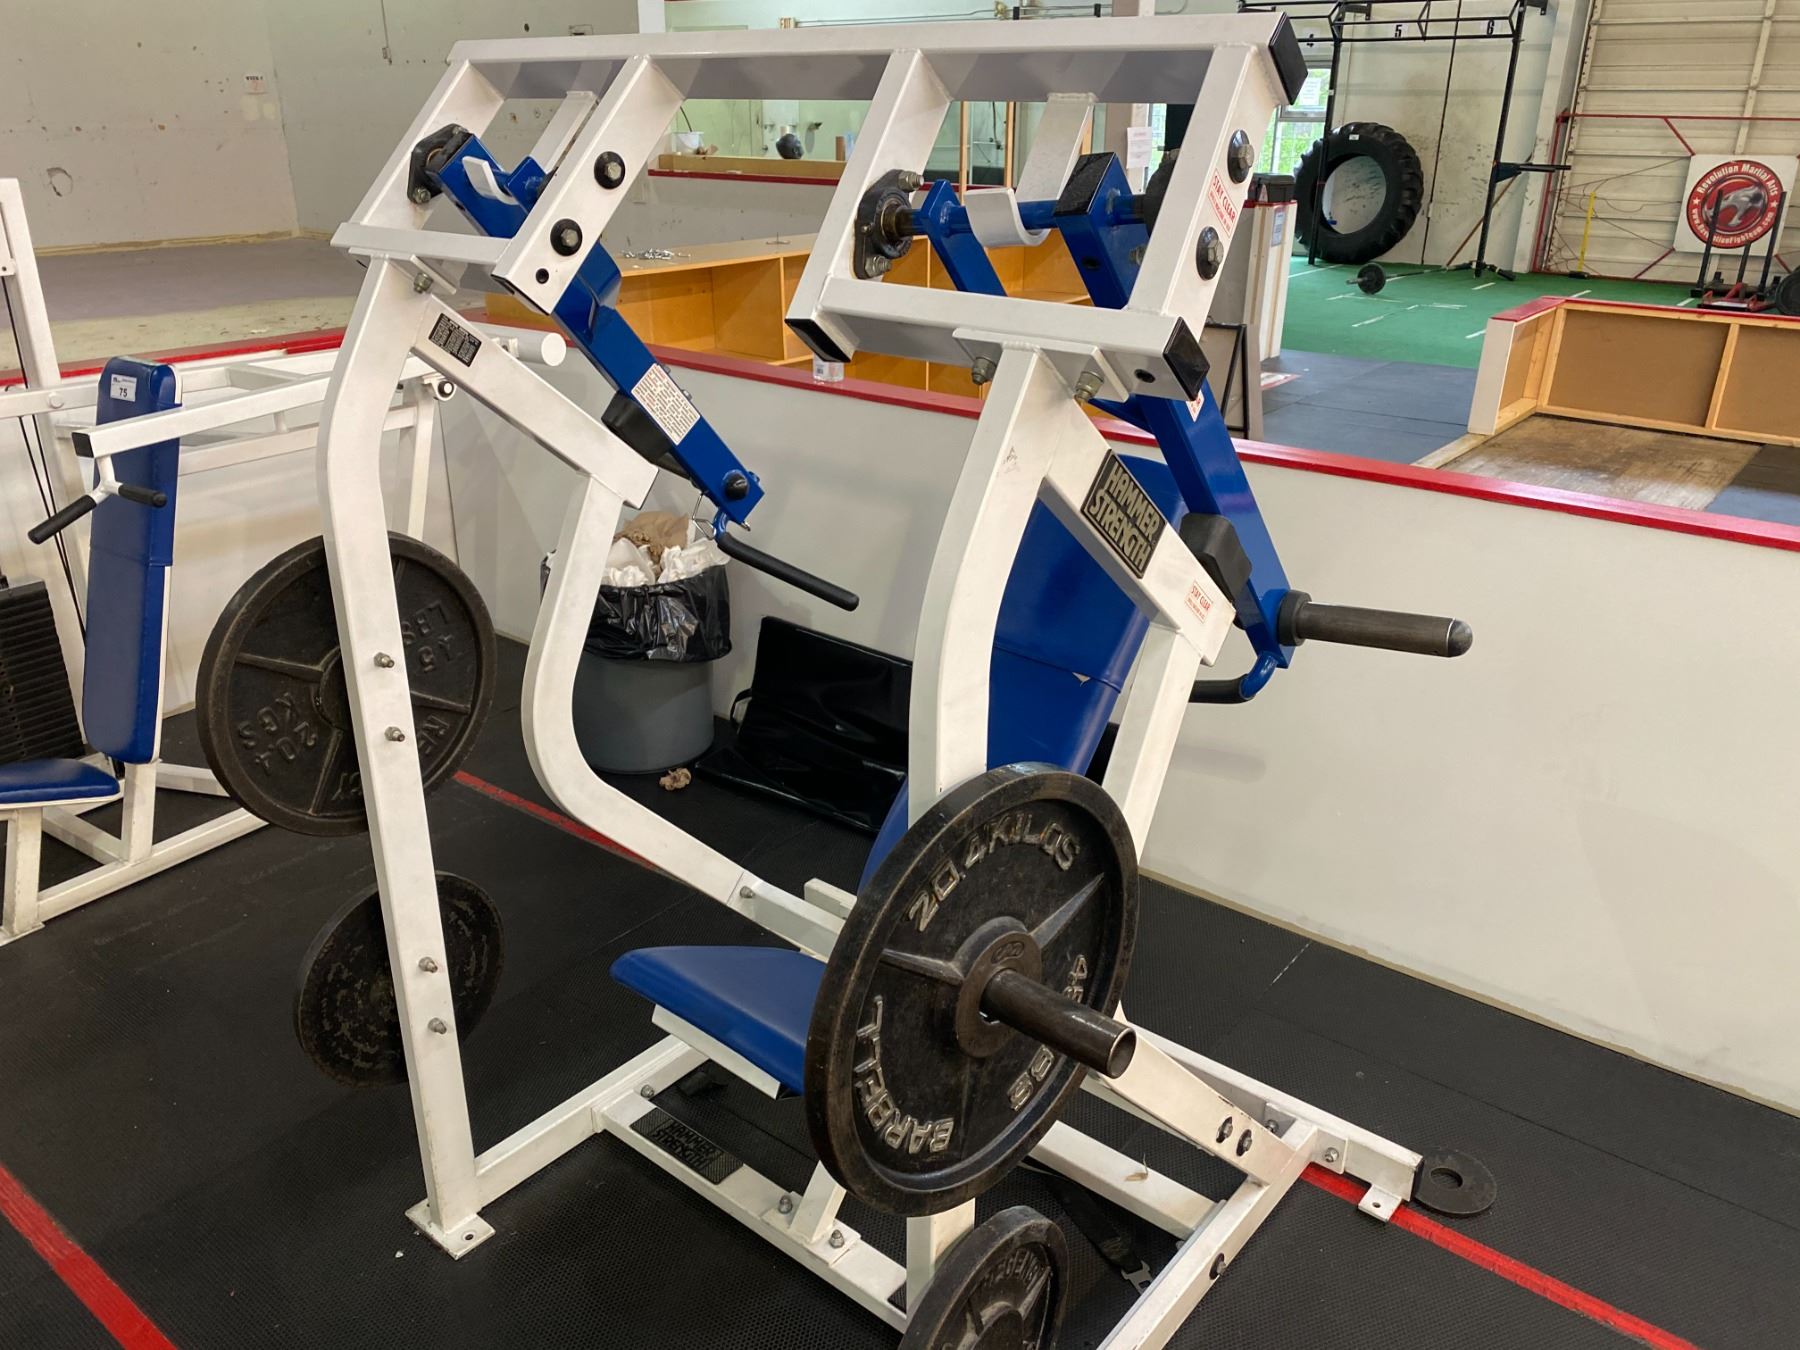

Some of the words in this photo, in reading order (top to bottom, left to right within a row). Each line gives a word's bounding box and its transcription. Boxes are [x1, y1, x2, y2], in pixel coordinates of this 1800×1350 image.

[1394, 24, 1403, 39] 5
[1486, 19, 1495, 36] 6
[1213, 175, 1224, 198] STAY
[1222, 196, 1236, 223] CLEAR
[1697, 165, 1739, 193] Revolution
[1742, 163, 1772, 182] Martial
[1766, 180, 1778, 196] Arts
[119, 387, 128, 398] 75
[1104, 460, 1160, 541] HAMMER
[1089, 488, 1152, 571] STRENGTH
[238, 691, 298, 747] KGS
[853, 994, 955, 1155] BARBELL
[650, 1128, 710, 1170] STRENGTH
[666, 1119, 718, 1155] HAMMER
